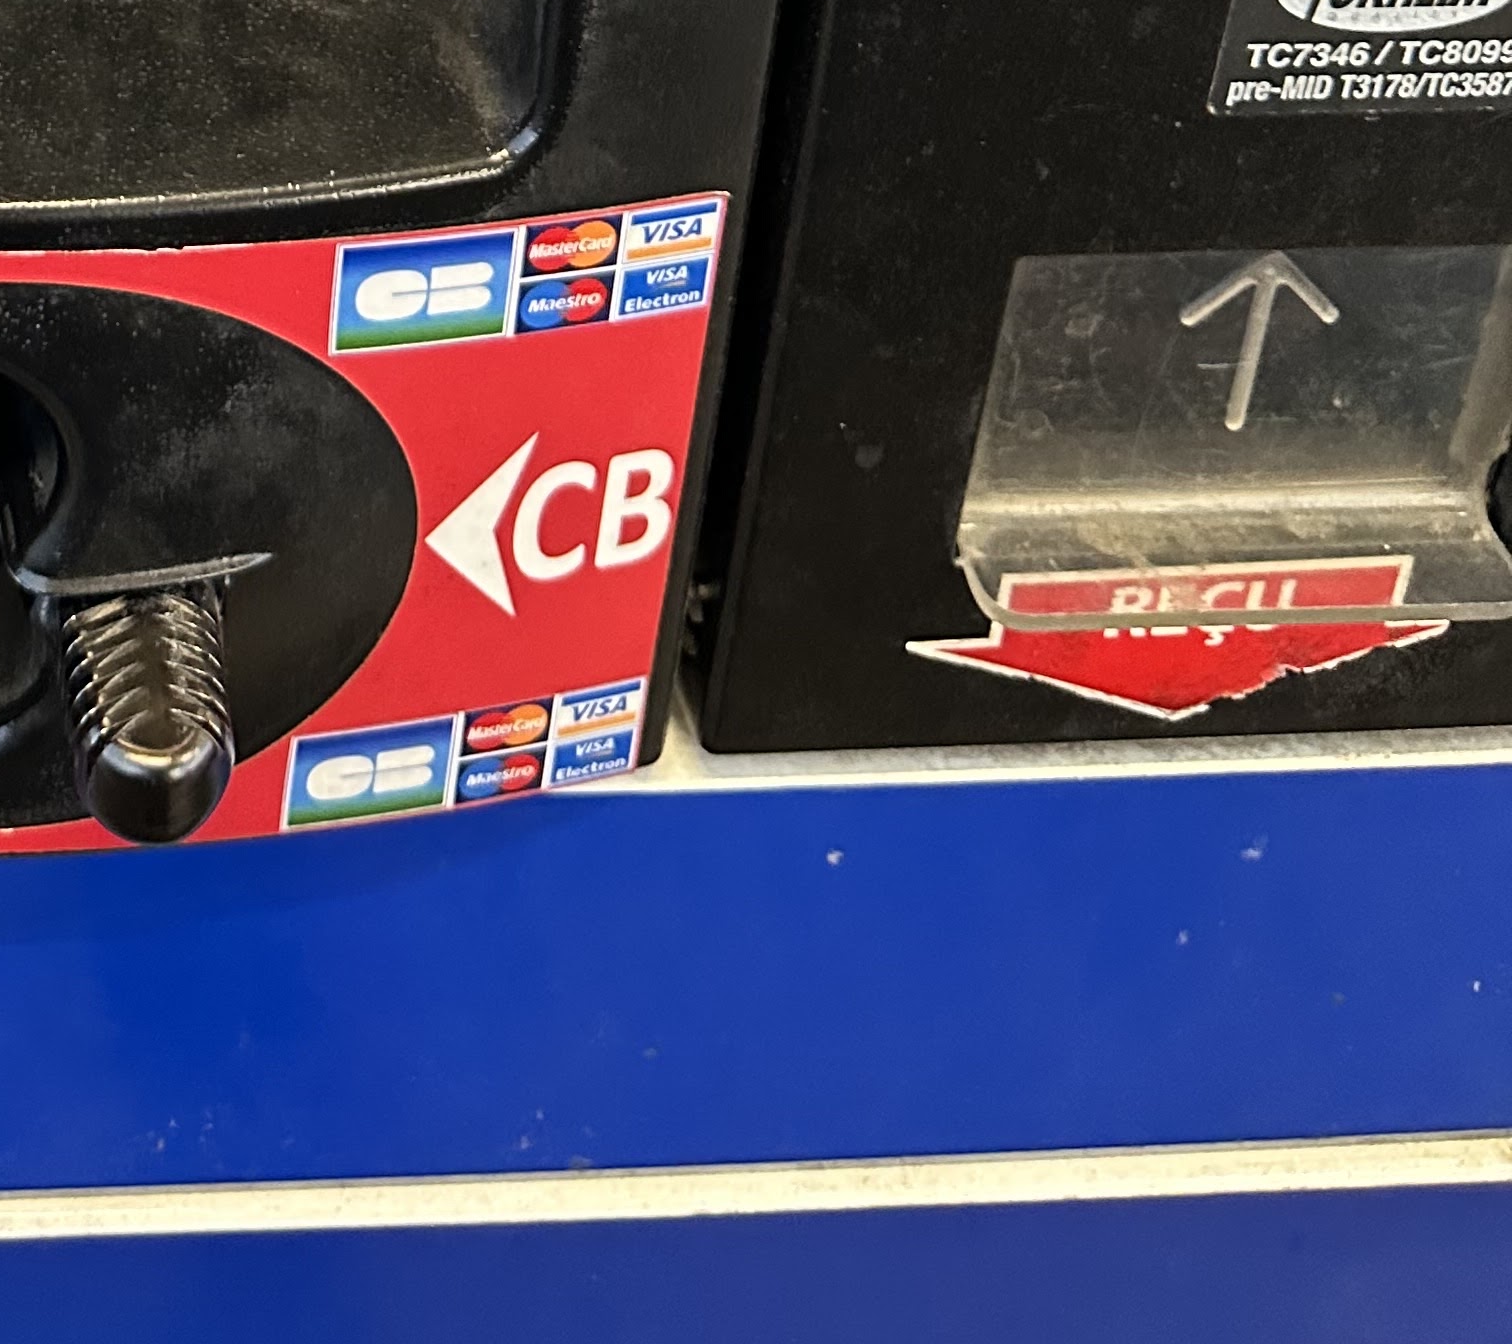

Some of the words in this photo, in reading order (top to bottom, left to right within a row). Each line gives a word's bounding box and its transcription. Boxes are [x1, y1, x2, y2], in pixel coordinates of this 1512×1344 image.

[1246, 41, 1372, 69] TC7346
[1374, 40, 1395, 65] /
[1399, 38, 1512, 66] TC8099
[1226, 74, 1334, 107] pre-MID
[1340, 71, 1512, 100] T3178/TC3587
[641, 217, 703, 245] VISA
[528, 234, 614, 260] MasterCard
[645, 265, 688, 285] VISA
[527, 291, 603, 314] Maestro
[623, 287, 702, 314] Electron
[512, 448, 675, 582] CB
[572, 695, 629, 722] VISA
[466, 714, 547, 742] MasterCard
[575, 737, 615, 757] VISA
[465, 764, 535, 787] Maestro
[555, 756, 627, 782] Electron
